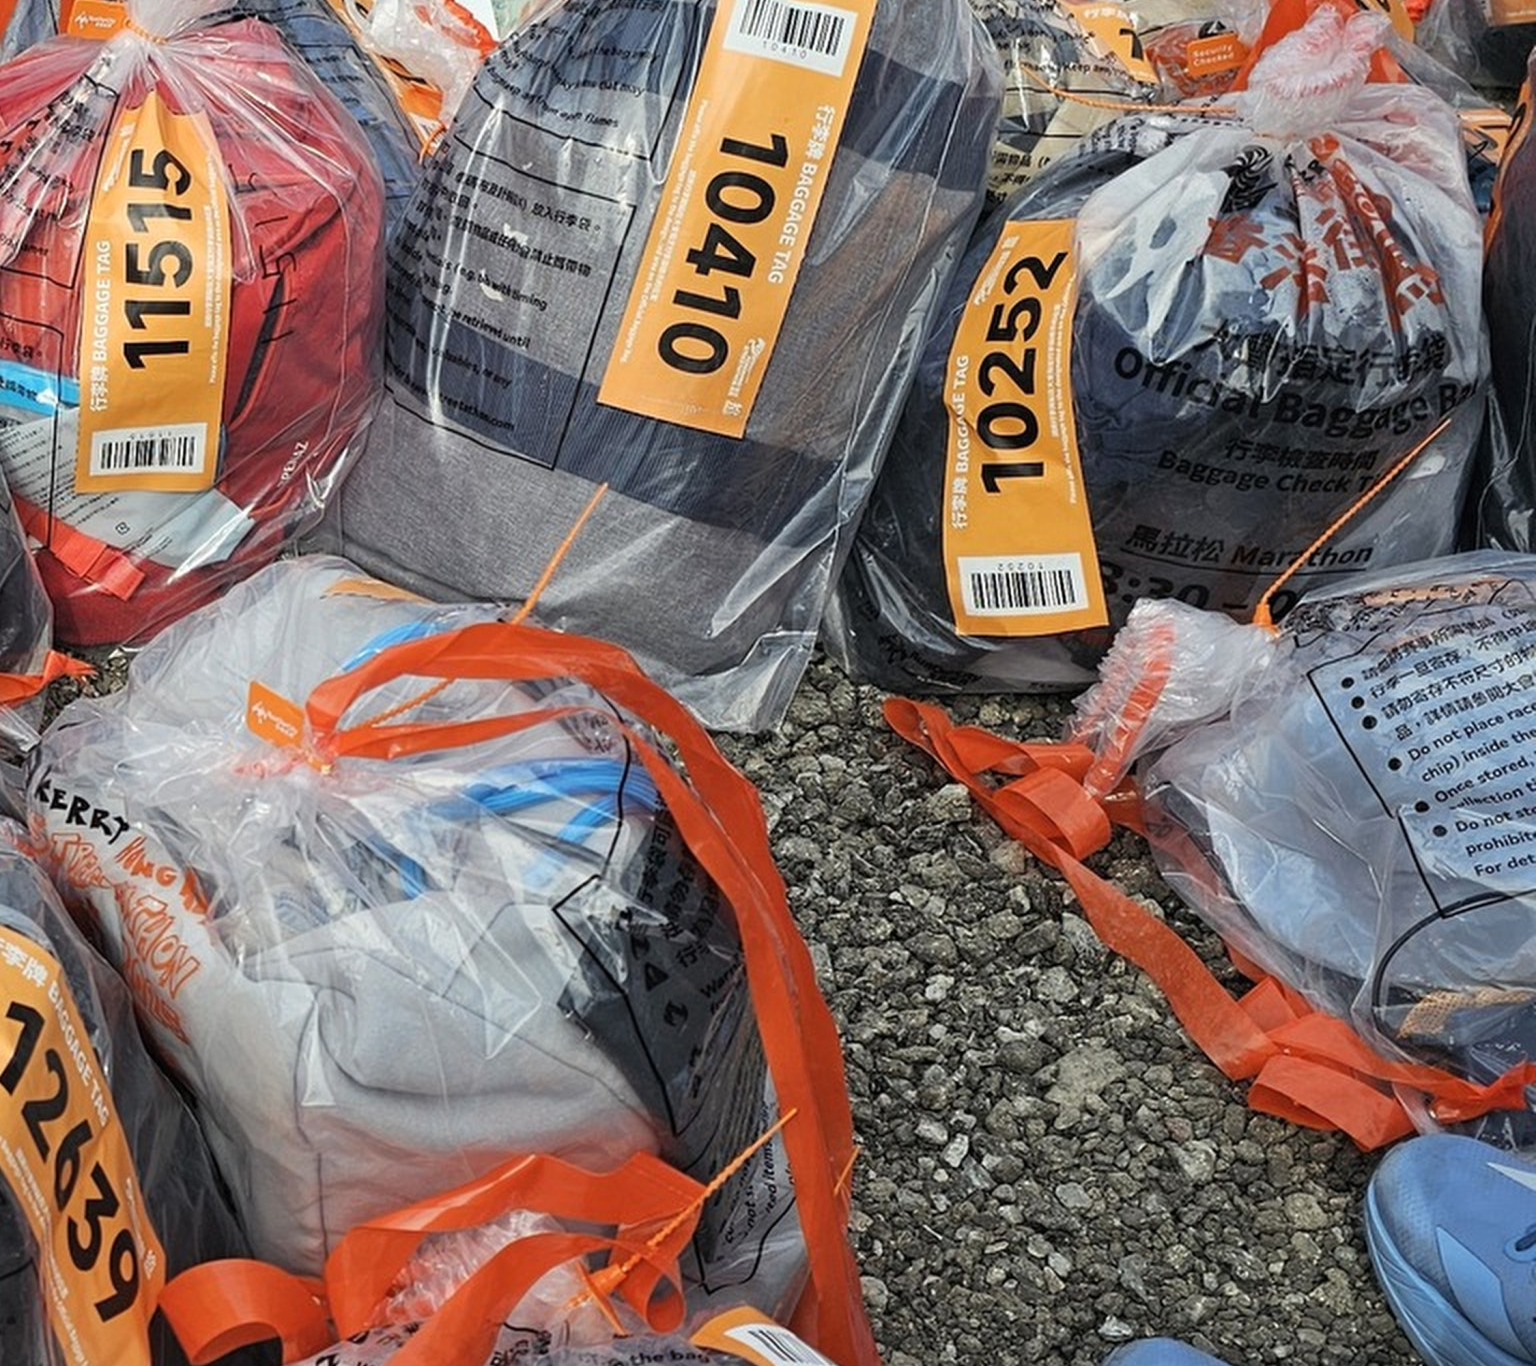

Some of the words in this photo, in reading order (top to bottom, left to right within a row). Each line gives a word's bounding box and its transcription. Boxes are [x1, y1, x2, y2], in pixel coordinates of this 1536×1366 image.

[761, 41, 810, 60] 10410
[1192, 45, 1233, 58] Security
[1192, 51, 1235, 67] Checked
[809, 104, 836, 164] 行李牌
[781, 162, 818, 247] BAGGAGE
[97, 240, 112, 274] TAG
[123, 147, 194, 371] 11515
[657, 132, 790, 376] 10410
[767, 247, 793, 285] TAG
[92, 277, 112, 361] BAGGAGE
[89, 365, 109, 413] 行李牌
[952, 355, 970, 389] TAG
[976, 251, 1070, 496] 10252
[1114, 345, 1269, 420] Official
[1275, 391, 1431, 438] Baggage
[952, 392, 970, 474] BAGGAGE
[1157, 449, 1270, 492] Baggage
[1277, 473, 1349, 494] Check
[951, 477, 969, 529] 行李牌
[1408, 742, 1432, 762] Do
[1433, 727, 1461, 749] not
[1465, 714, 1506, 743] place
[1422, 753, 1461, 783] chip)
[1464, 737, 1510, 762] inside
[1435, 777, 1474, 803] Once
[1477, 757, 1535, 784] stored,
[34, 765, 130, 845] KERRY
[1456, 818, 1480, 834] Do
[1483, 810, 1513, 828] not
[1474, 862, 1505, 877] For
[47, 981, 92, 1088] BAGGAGE
[82, 1080, 110, 1128] TAG
